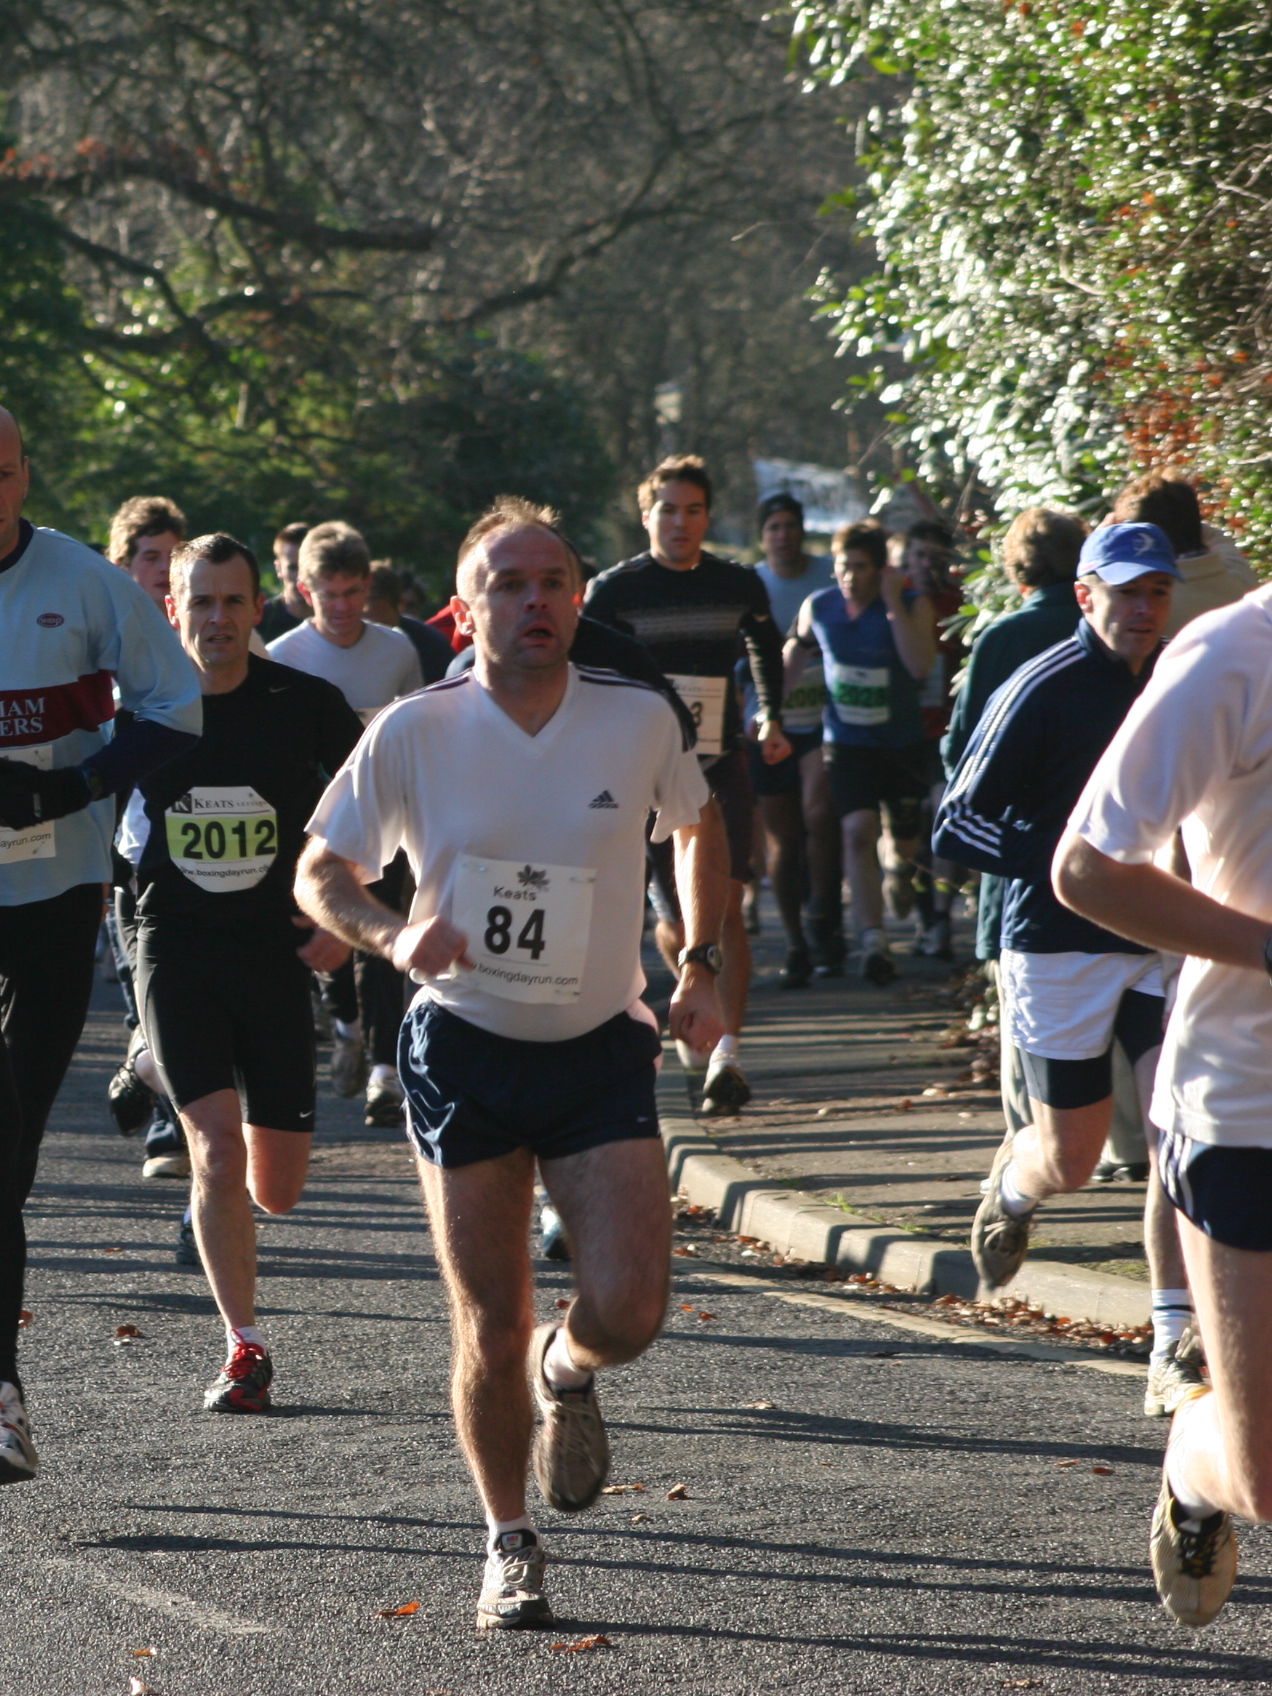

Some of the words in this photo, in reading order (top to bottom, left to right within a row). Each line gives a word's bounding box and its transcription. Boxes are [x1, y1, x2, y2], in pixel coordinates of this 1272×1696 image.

[194, 798, 234, 809] KEATS
[181, 819, 277, 860] 2012
[493, 885, 538, 901] Keats
[484, 905, 546, 960] 84
